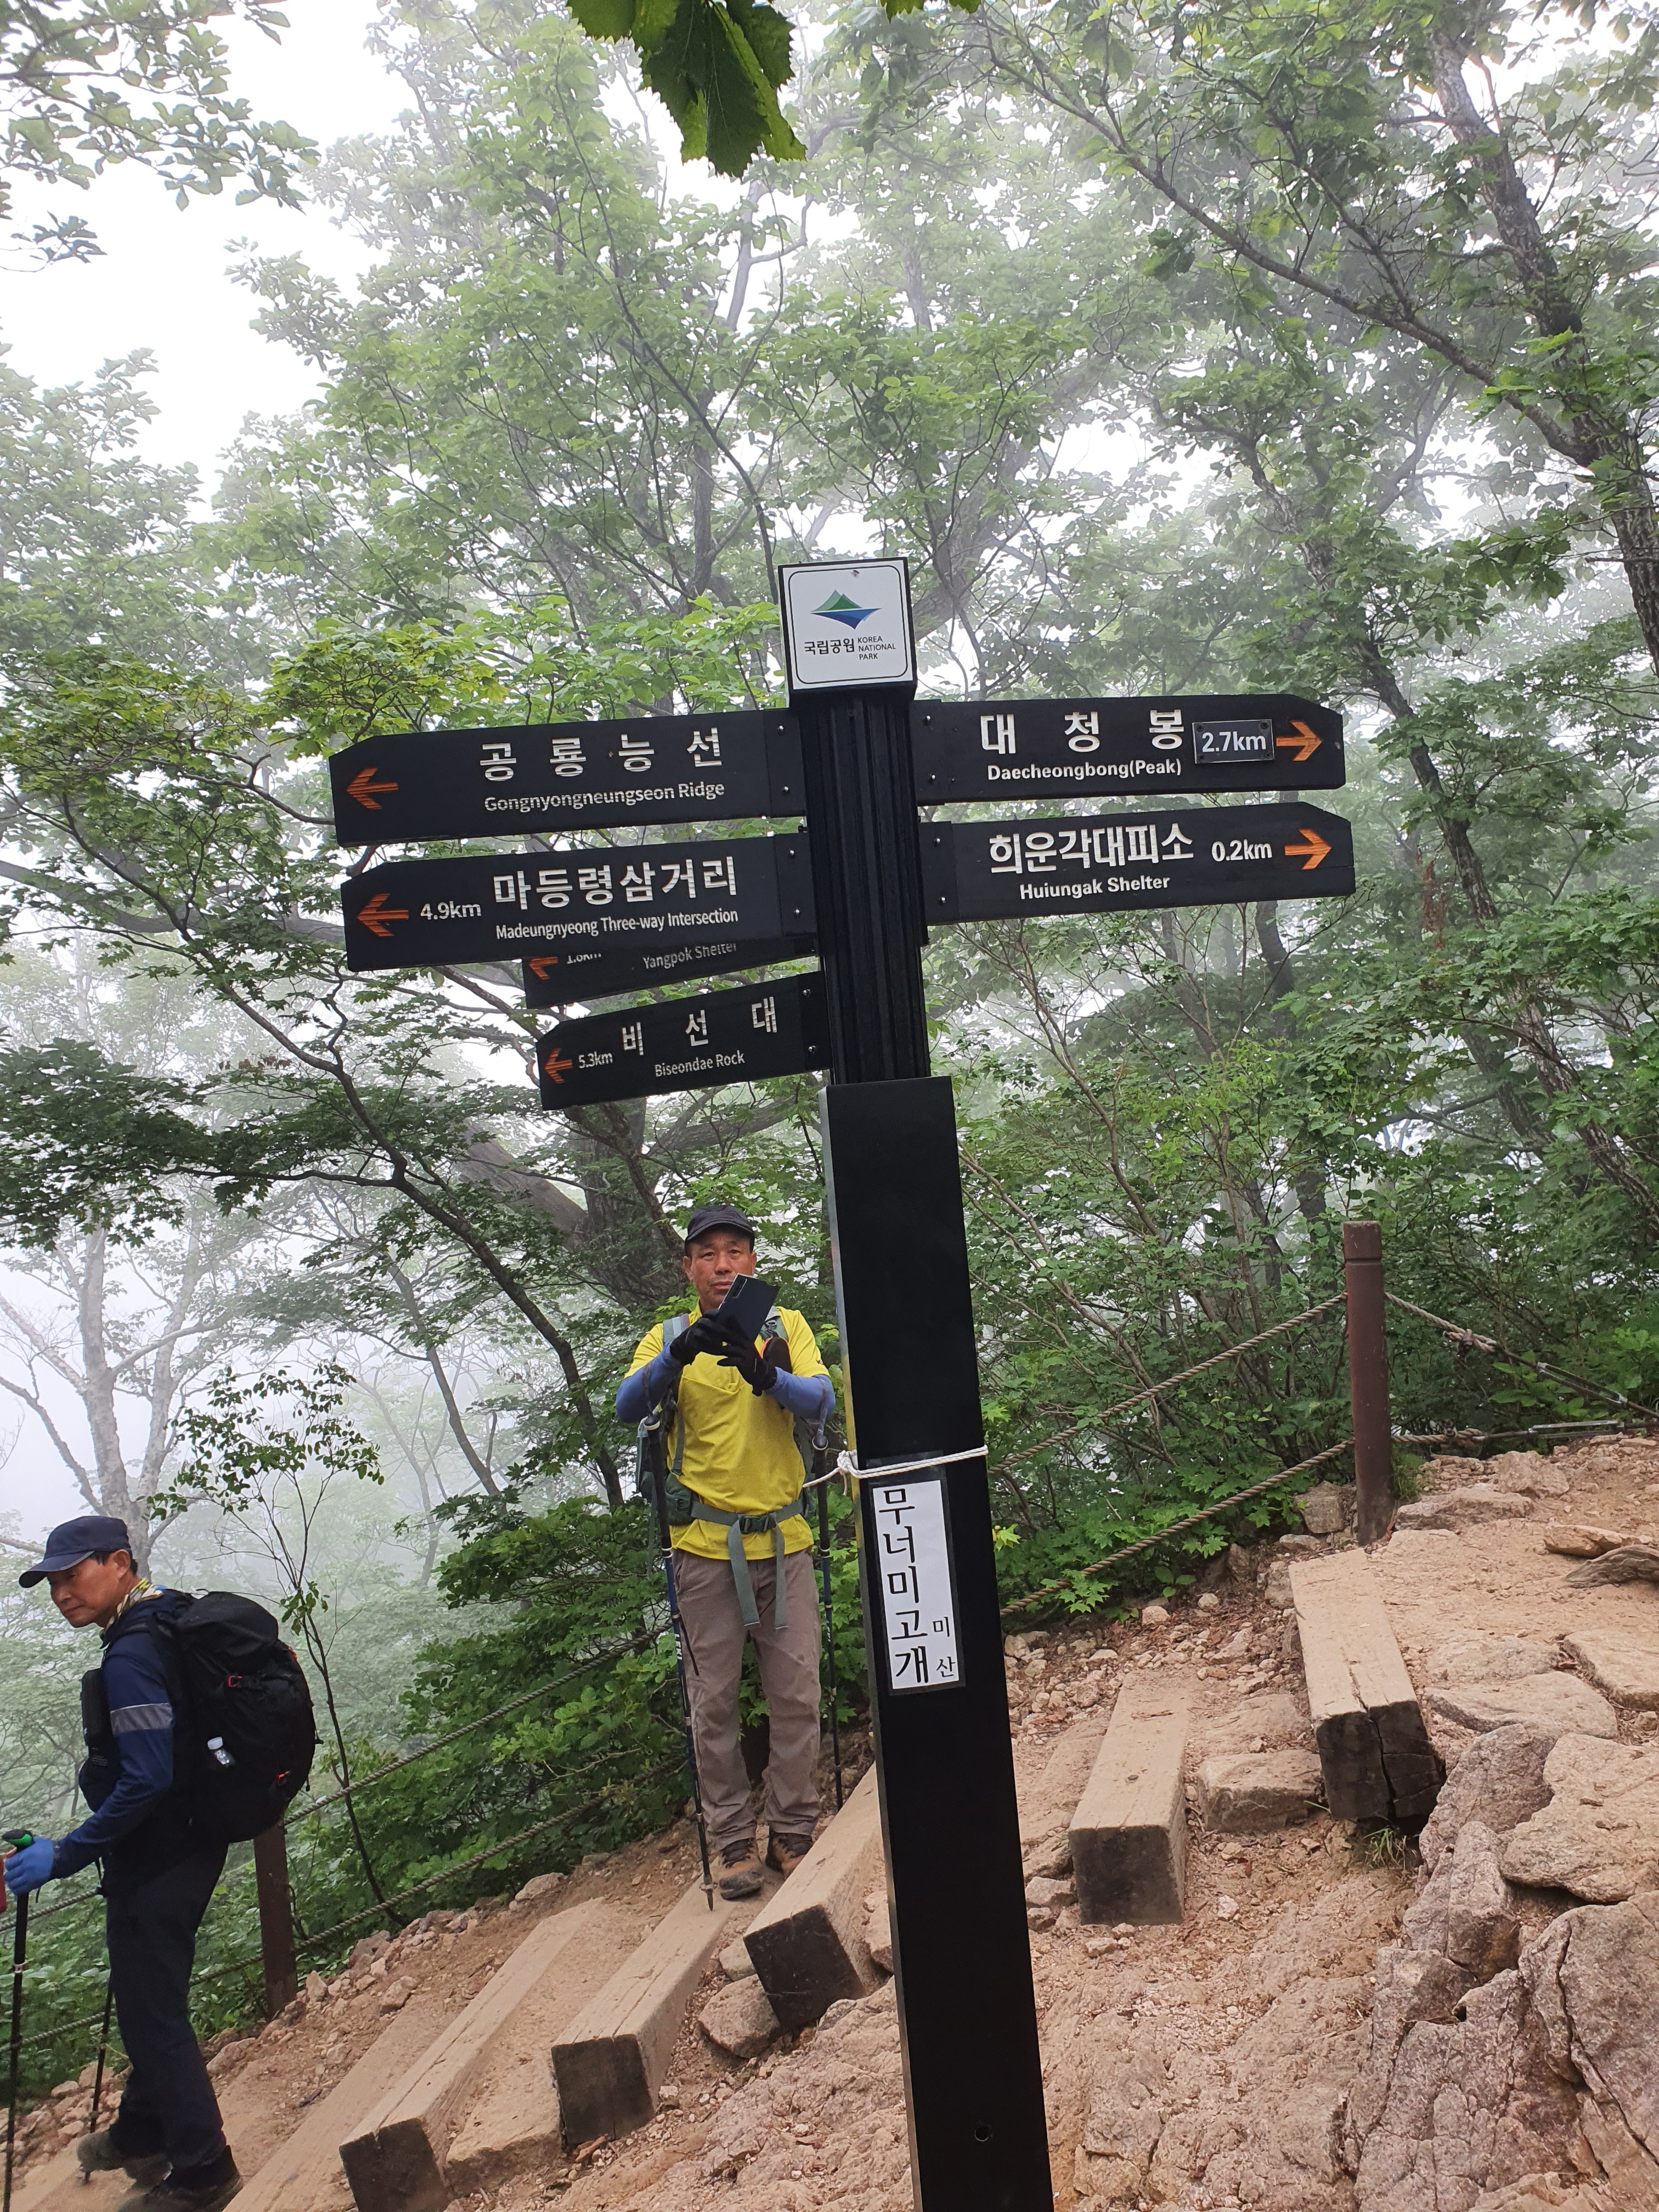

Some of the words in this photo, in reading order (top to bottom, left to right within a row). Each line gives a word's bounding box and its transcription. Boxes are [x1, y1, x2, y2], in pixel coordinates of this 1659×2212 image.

[804, 638, 854, 655] 국립공원
[859, 644, 896, 652] NATIONAL
[1202, 731, 1266, 752] 2.7km
[988, 759, 1181, 780] Daecheongbong(Peak)
[485, 788, 674, 812] Gongnyongneungseon
[679, 782, 724, 800] Ridge
[990, 823, 1193, 873] 희운각대피소
[1212, 839, 1272, 861] 0.2km
[421, 901, 481, 919] 4.9km
[494, 856, 736, 910] 마등령삼거리
[1020, 879, 1103, 899] Huiungak
[1108, 876, 1170, 891] Shelter
[496, 922, 599, 939] Madeungnyeong
[600, 916, 664, 931] Three-way
[668, 908, 738, 927] Intersection
[644, 947, 692, 969] Yangpok
[579, 1052, 613, 1068] 5.3km
[655, 1057, 713, 1076] Biseondae
[716, 1050, 745, 1067] Rock
[879, 1488, 929, 1683] 무너미고개
